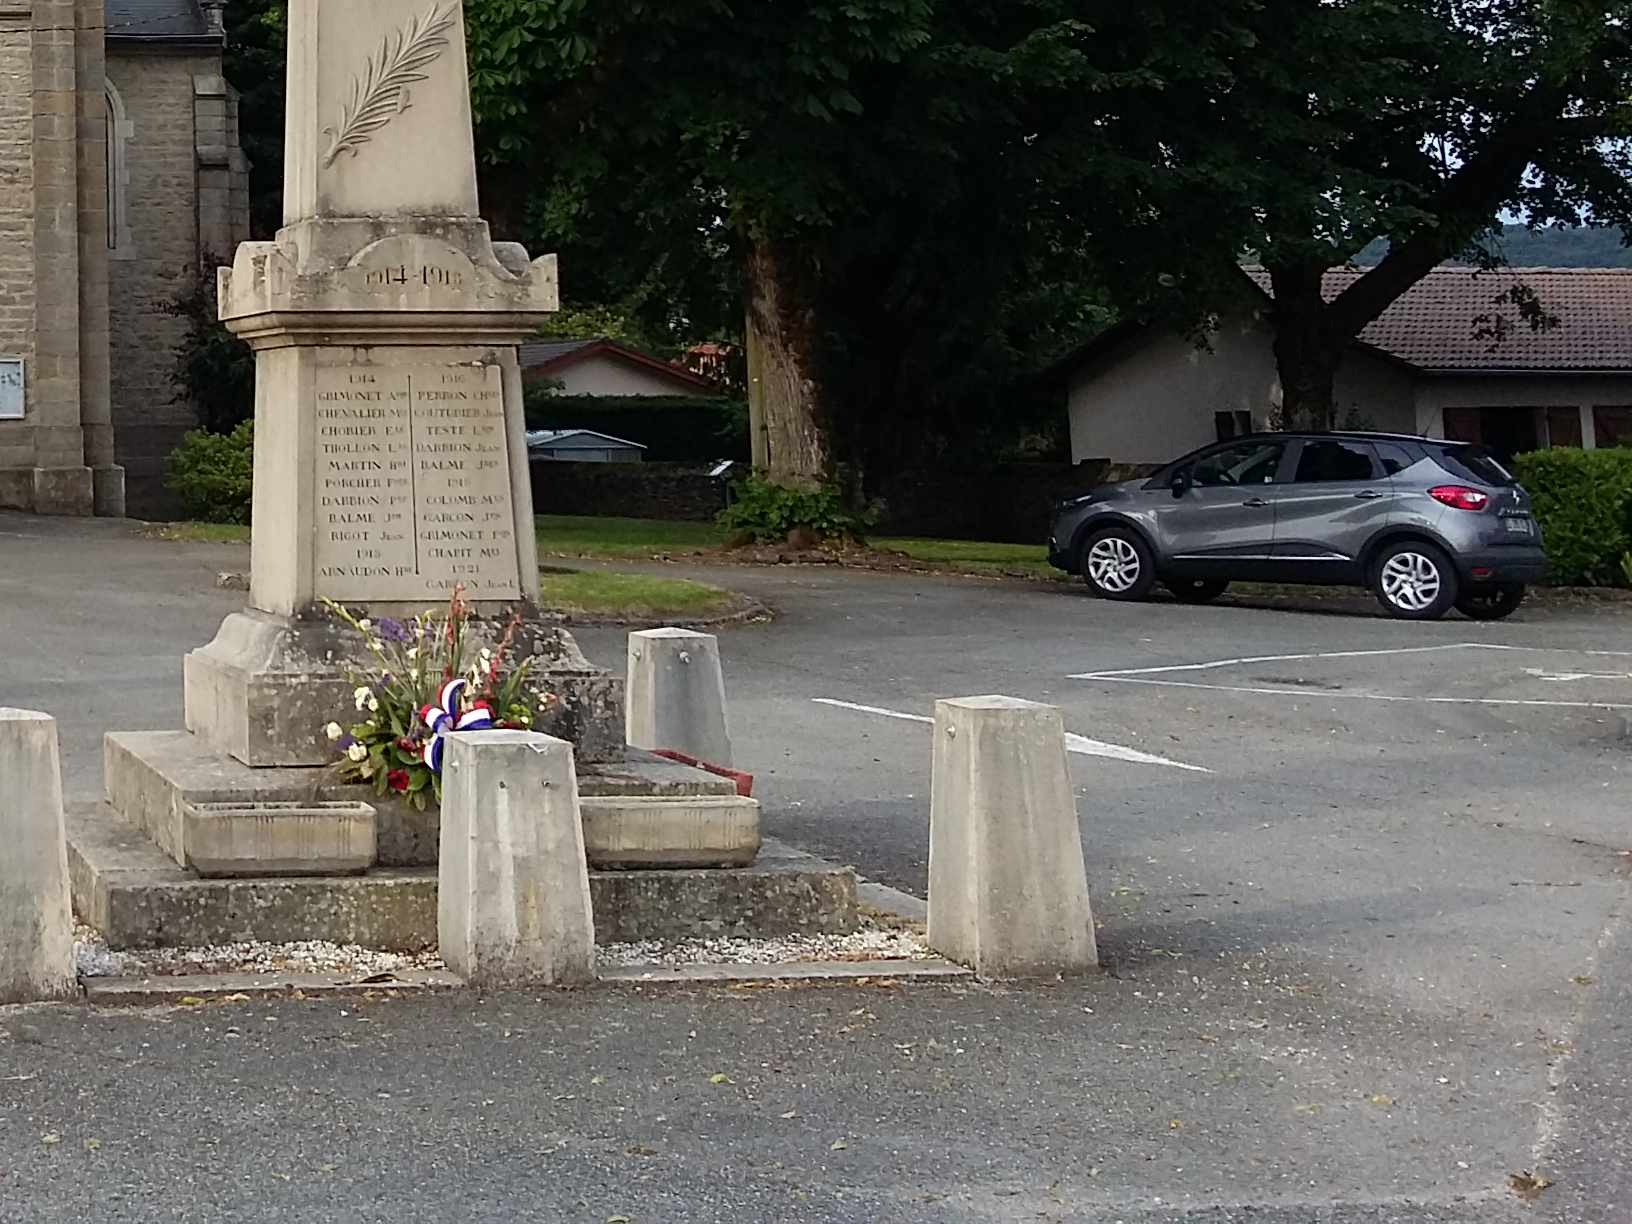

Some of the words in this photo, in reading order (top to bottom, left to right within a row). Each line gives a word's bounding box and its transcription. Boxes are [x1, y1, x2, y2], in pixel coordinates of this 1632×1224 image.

[349, 374, 376, 384] 1914
[318, 408, 386, 419] CHEVALIER
[328, 461, 381, 471] MARTIN
[421, 460, 467, 470] BALME
[426, 495, 476, 505] COLOMB
[328, 513, 376, 523] BALME
[331, 531, 370, 541] RIGOT
[420, 530, 484, 541] GRIMONET
